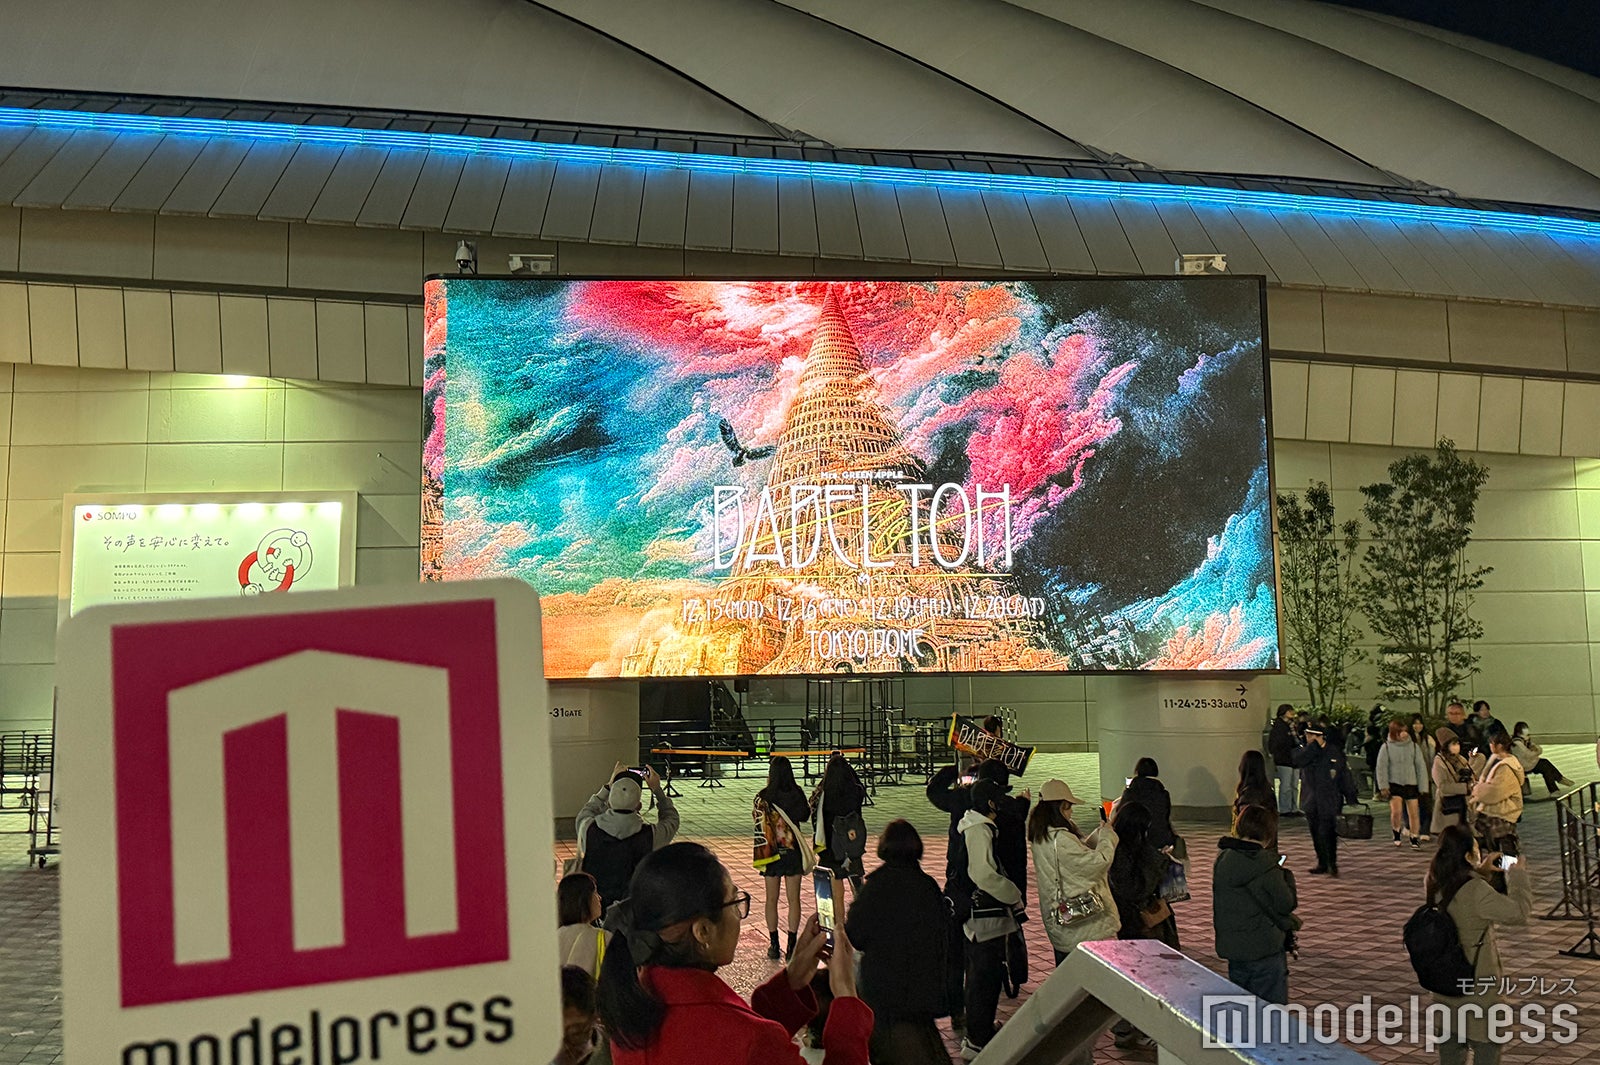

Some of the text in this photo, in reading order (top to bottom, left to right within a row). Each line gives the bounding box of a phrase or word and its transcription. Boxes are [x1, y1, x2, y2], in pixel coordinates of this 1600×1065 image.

[821, 470, 903, 479] Mrs. GREEN APPLE
[904, 483, 1012, 567] TOH
[104, 533, 230, 553] その声を安心に変えて。
[807, 629, 923, 658] TOKYO DOME
